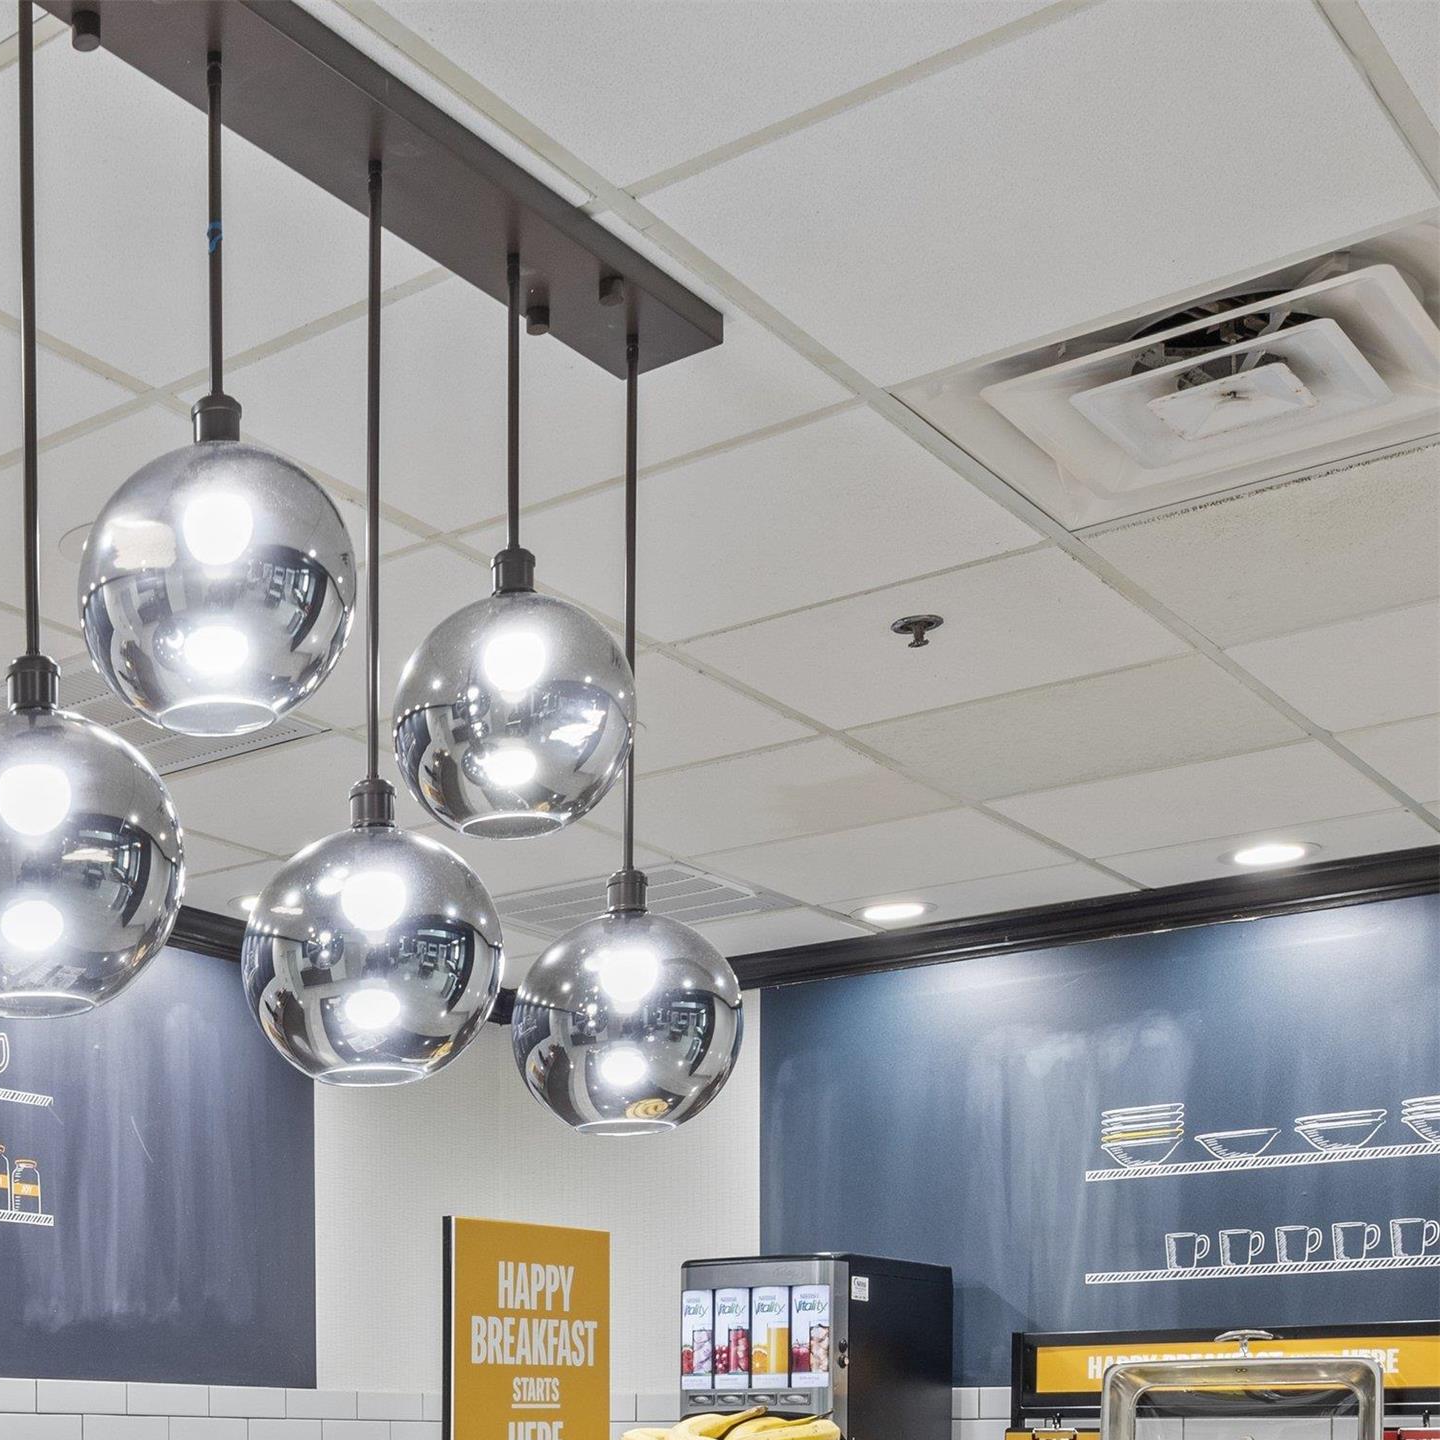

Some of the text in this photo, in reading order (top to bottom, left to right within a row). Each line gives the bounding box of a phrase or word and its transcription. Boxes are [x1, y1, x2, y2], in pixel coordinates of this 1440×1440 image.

[498, 1260, 575, 1312] HAPPY
[795, 1298, 829, 1315] Vitality
[471, 1315, 598, 1367] BREAKFAST
[512, 1377, 560, 1402] STARTS
